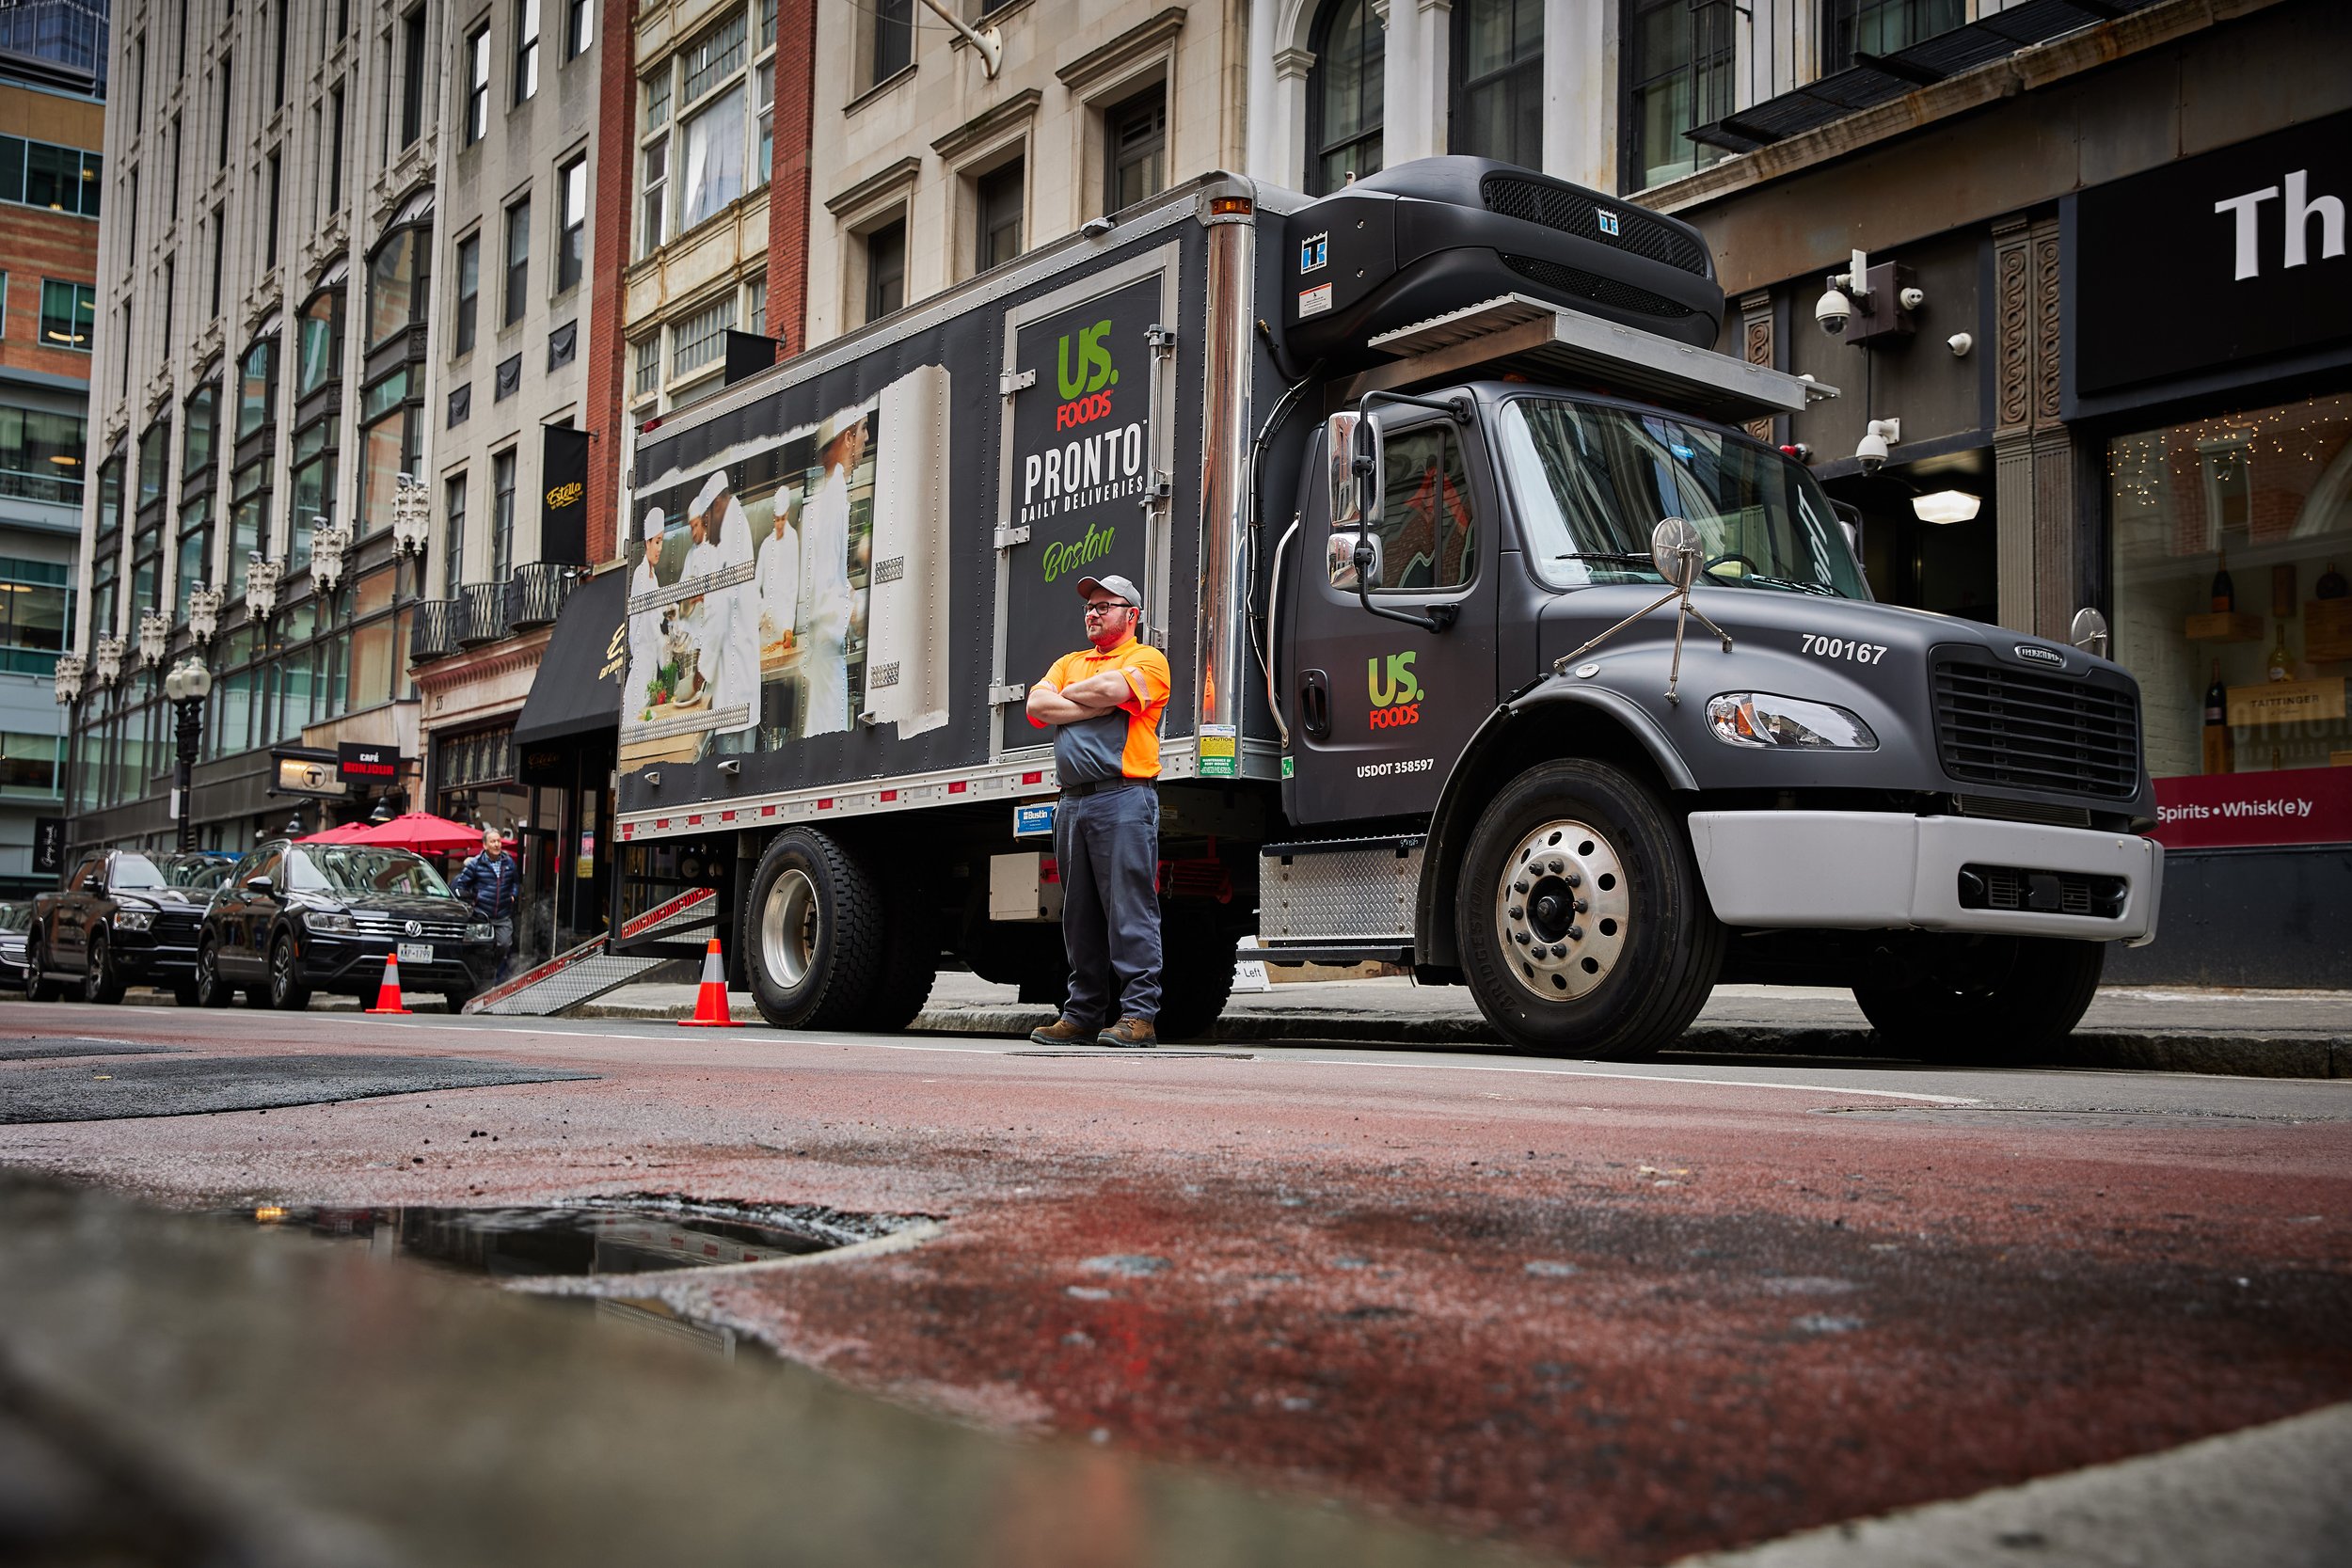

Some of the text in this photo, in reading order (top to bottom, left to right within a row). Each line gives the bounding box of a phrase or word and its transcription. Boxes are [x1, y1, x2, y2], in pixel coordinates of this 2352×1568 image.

[1021, 475, 1144, 524] DAILY DELIVERIES
[1042, 523, 1116, 583] Boston
[1802, 633, 1887, 665] 700167
[2249, 695, 2320, 708] TAITTINGER
[359, 752, 379, 763] CAFÉ
[343, 761, 394, 775] BONJOUR
[1357, 758, 1435, 778] USDOT 358597
[307, 770, 322, 785] T
[1028, 809, 1048, 819] Bustin
[2156, 798, 2313, 824] Spirits Whisk(e)y
[1243, 968, 1262, 977] Left
